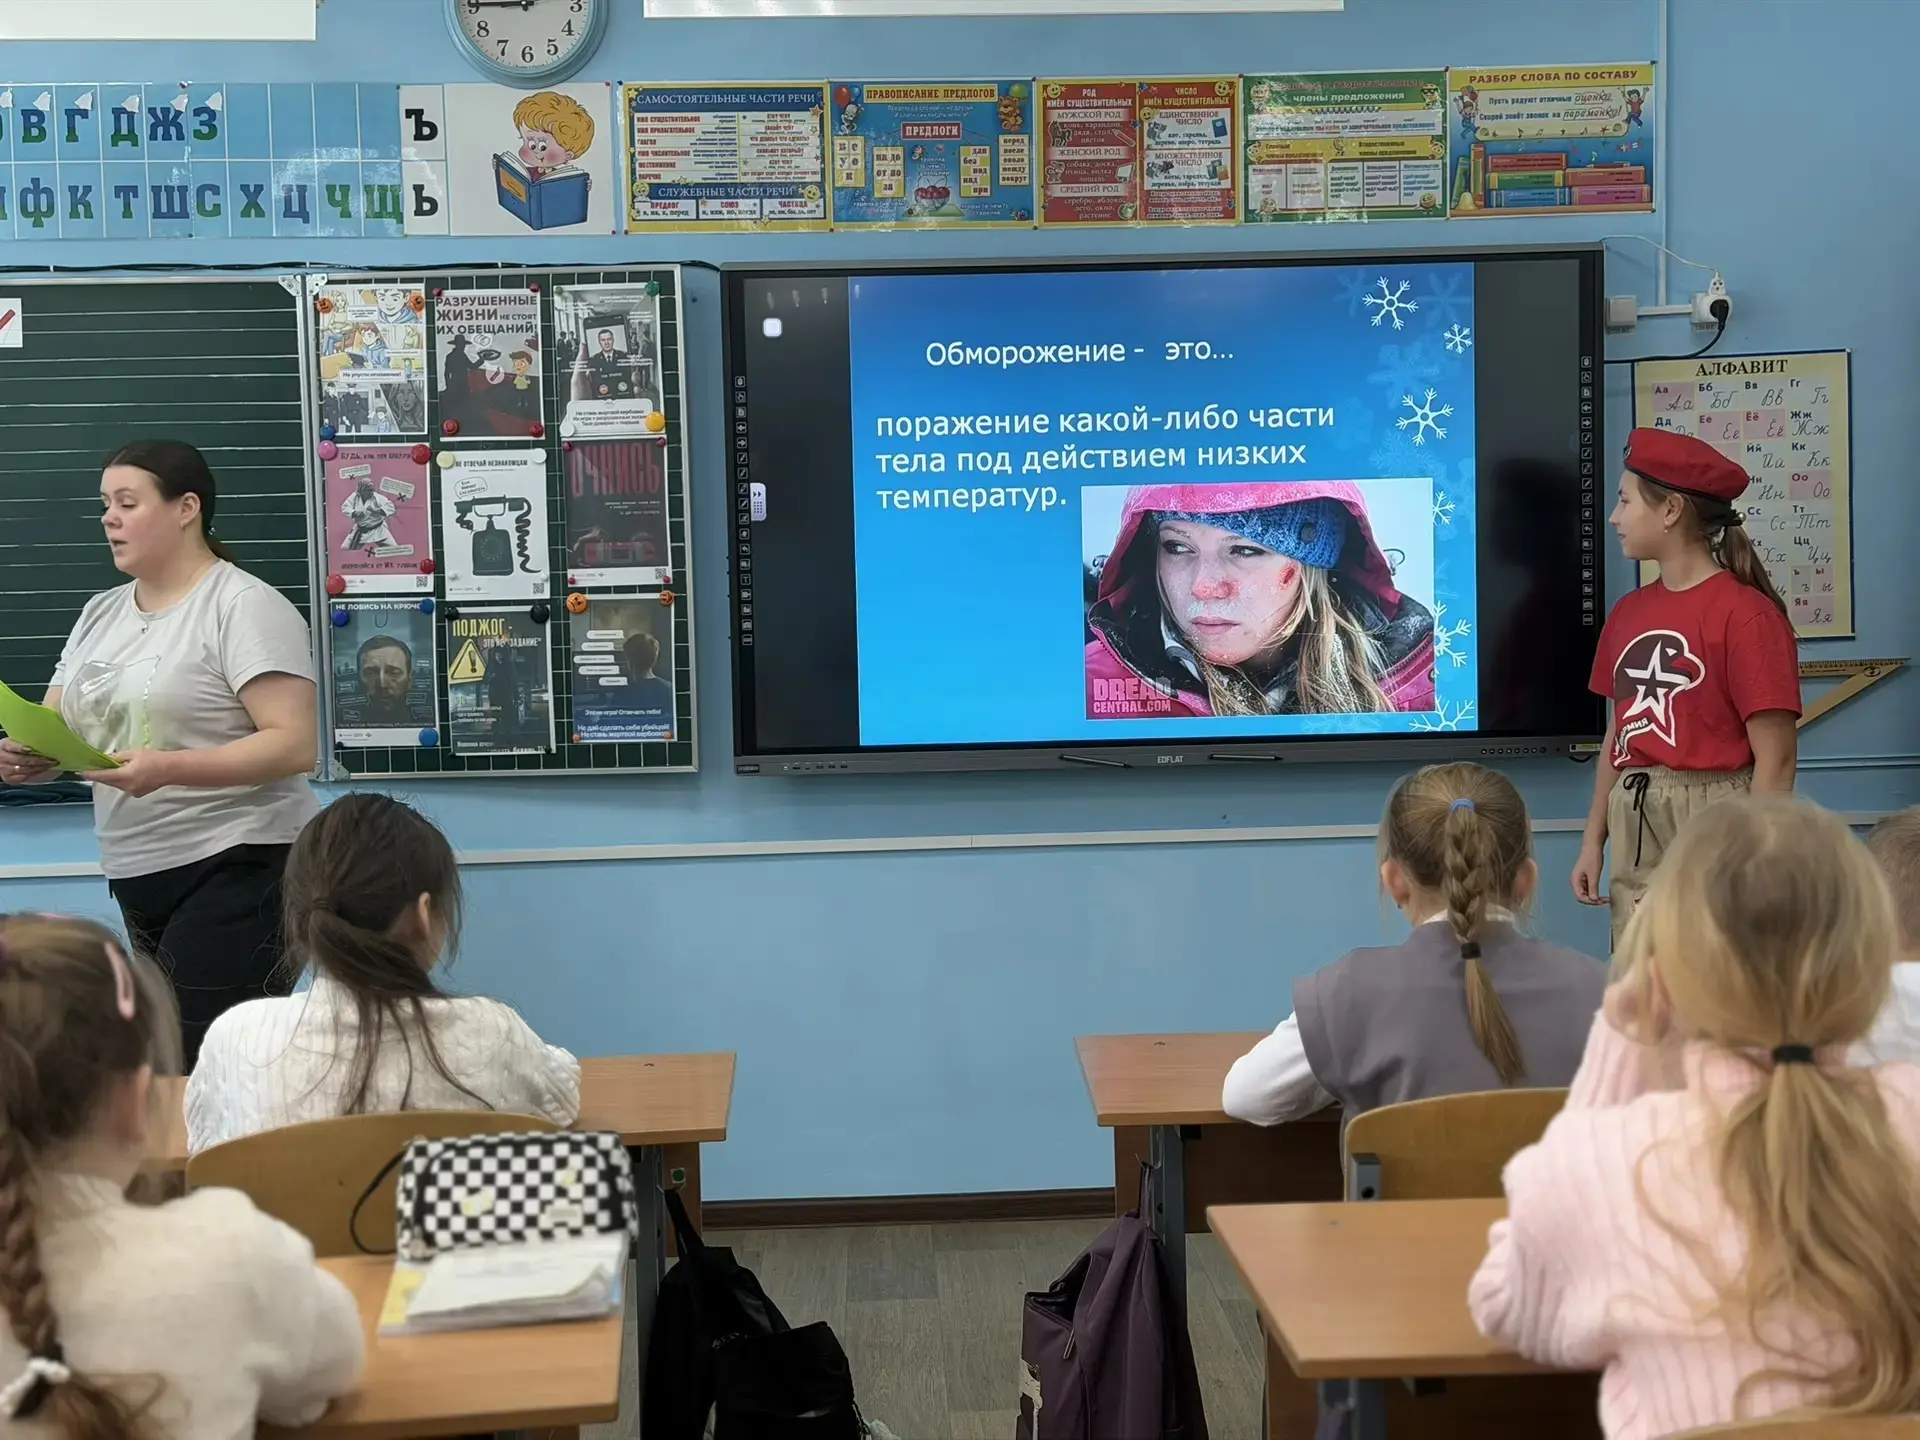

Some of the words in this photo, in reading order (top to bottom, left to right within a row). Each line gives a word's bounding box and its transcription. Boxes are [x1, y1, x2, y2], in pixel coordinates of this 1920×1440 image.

[569, 0, 583, 12] 3
[476, 20, 490, 37] 8
[561, 19, 574, 36] 4
[497, 39, 509, 57] 7
[547, 38, 558, 56] 5
[521, 46, 534, 63] 6
[1469, 75, 1516, 84] РАЗБОР
[1521, 73, 1560, 82] СЛОВА
[1565, 72, 1580, 80] ПО
[1584, 70, 1638, 80] СОСТАВУ
[866, 89, 939, 99] ПРАВОПИСАНИЕ
[943, 88, 995, 99] ПРЕДЛОГОВ
[1082, 89, 1097, 97] РОД
[1293, 93, 1328, 102] члены
[1331, 93, 1405, 102] предложения
[637, 94, 747, 105] САМОСТОЯТЕЛЬНЫЕ
[749, 94, 783, 103] ЧАСТИ
[785, 93, 815, 103] РЕЧИ
[1067, 98, 1133, 108] СУЩЕСТВИТЕЛЬНЫХ
[1489, 97, 1509, 105] Пусть
[1511, 97, 1537, 105] радуют
[1057, 111, 1102, 119] МУЖСКОЙ
[1160, 111, 1219, 119] ЕДИНСТВЕННОЕ
[21, 109, 46, 143] В
[64, 108, 89, 143] Г
[111, 107, 139, 147] Д
[148, 107, 185, 141] Ж
[193, 107, 218, 140] З
[405, 108, 438, 141] Ъ
[1176, 118, 1203, 126] ЧИСЛО
[905, 126, 958, 137] ПРЕДЛОГИ
[1058, 148, 1102, 156] ЖЕНСКИЙ
[1155, 152, 1223, 160] МНОЖЕСТВЕННОЕ
[658, 188, 725, 197] СЛУЖЕБНЫЕ
[727, 188, 763, 197] ЧАСТИ
[767, 187, 793, 196] РЕЧИ
[68, 185, 93, 219] К
[114, 185, 139, 219] Т
[151, 185, 190, 219] Ш
[196, 183, 222, 218] С
[240, 184, 265, 218] Х
[283, 184, 310, 224] Ц
[325, 184, 352, 218] Ч
[364, 184, 403, 224] Щ
[413, 184, 438, 216] Ь
[436, 296, 537, 307] РАЗРУШЕННЫЕ
[437, 309, 498, 321] ЖИЗНИ
[437, 325, 454, 335] ИХ
[457, 321, 538, 335] ОБЕЩАНИЙ!
[926, 341, 1126, 369] Обморожение
[1165, 341, 1234, 361] это...
[1696, 359, 1788, 377] АЛФАВИТ
[1699, 382, 1713, 392] Бб
[1745, 381, 1758, 390] Вв
[1790, 379, 1801, 388] Гг
[1654, 385, 1669, 395] Аа
[1699, 415, 1712, 424] Ее
[1790, 411, 1812, 419] Жж
[876, 411, 1049, 441] поражение
[1059, 404, 1238, 434] какой-либо
[1248, 404, 1335, 431] части
[1655, 416, 1672, 427] Дд
[1791, 442, 1806, 451] Кк
[463, 459, 486, 467] ОТВЕЧАЙ
[876, 449, 946, 473] тела
[957, 449, 1012, 477] под
[1022, 444, 1186, 475] действием
[1198, 443, 1306, 466] низких
[571, 443, 661, 498] ОЧНИСЬ
[1791, 474, 1808, 482] Оо
[877, 484, 1066, 512] температур.
[1747, 507, 1761, 515] Сс
[1793, 505, 1805, 513] Тт
[453, 619, 505, 637] ПОДЖОГ
[1093, 700, 1171, 713] CENTRAL.COM
[1157, 755, 1184, 764] EDFLAT
